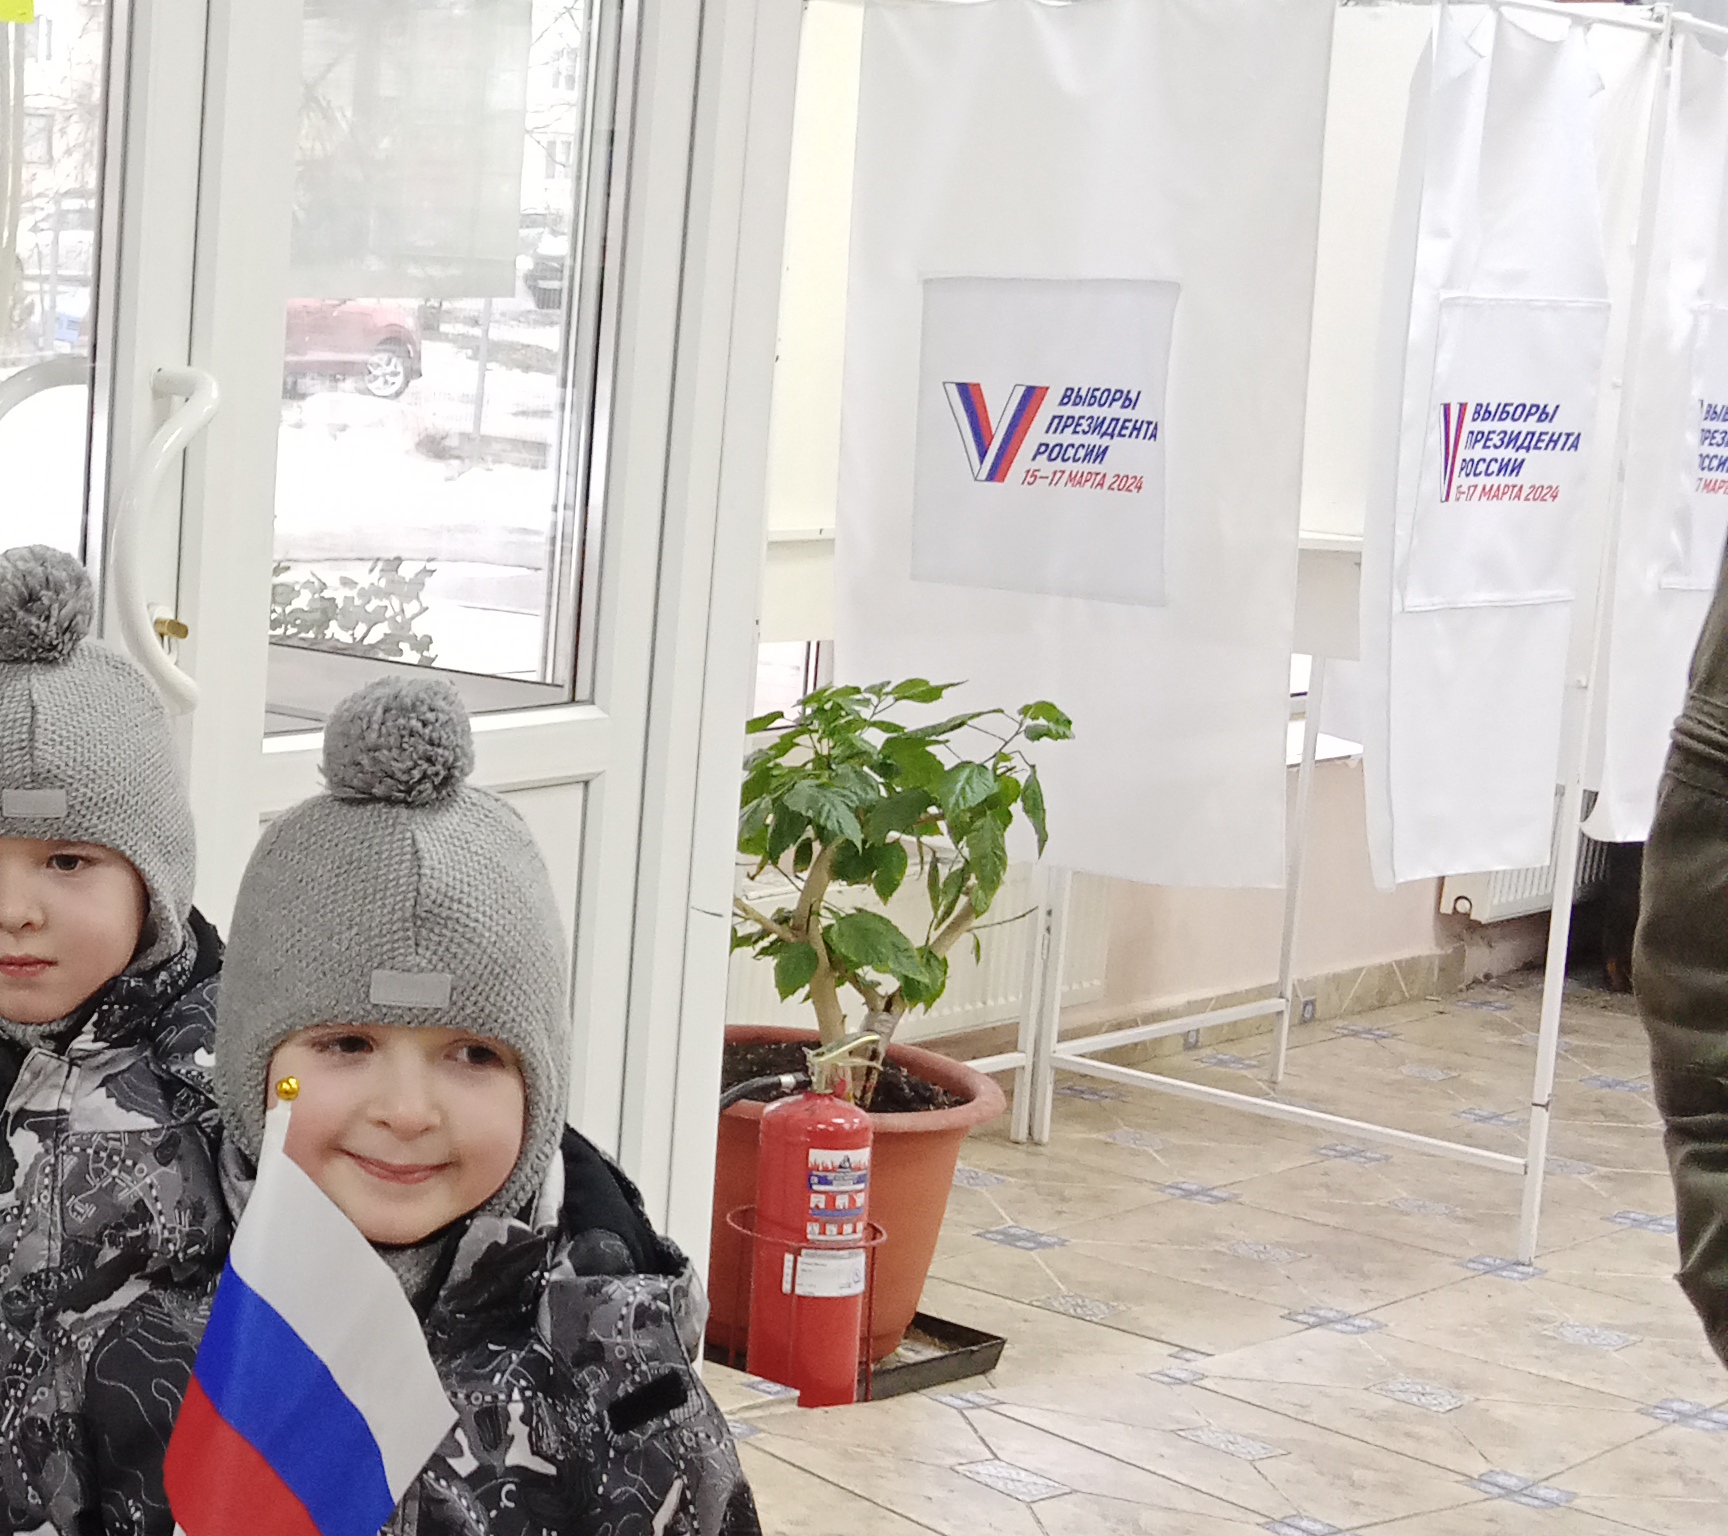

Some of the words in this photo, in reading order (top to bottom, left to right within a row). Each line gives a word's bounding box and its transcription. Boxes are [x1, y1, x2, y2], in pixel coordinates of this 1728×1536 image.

[1058, 386, 1141, 411] ВЫБОРЫ
[1471, 402, 1560, 424] ВЫБОРЫ
[1044, 415, 1158, 442] ПРЕЗИДЕНТА
[1464, 430, 1582, 453] ПРЕЗИДЕНТА
[1031, 442, 1110, 465] РОССИИ
[1458, 457, 1526, 478] РОССИИ
[1064, 470, 1106, 490] МАРТА
[1107, 474, 1144, 494] 2024
[1478, 484, 1524, 502] МАРТА
[1524, 484, 1560, 503] 2024
